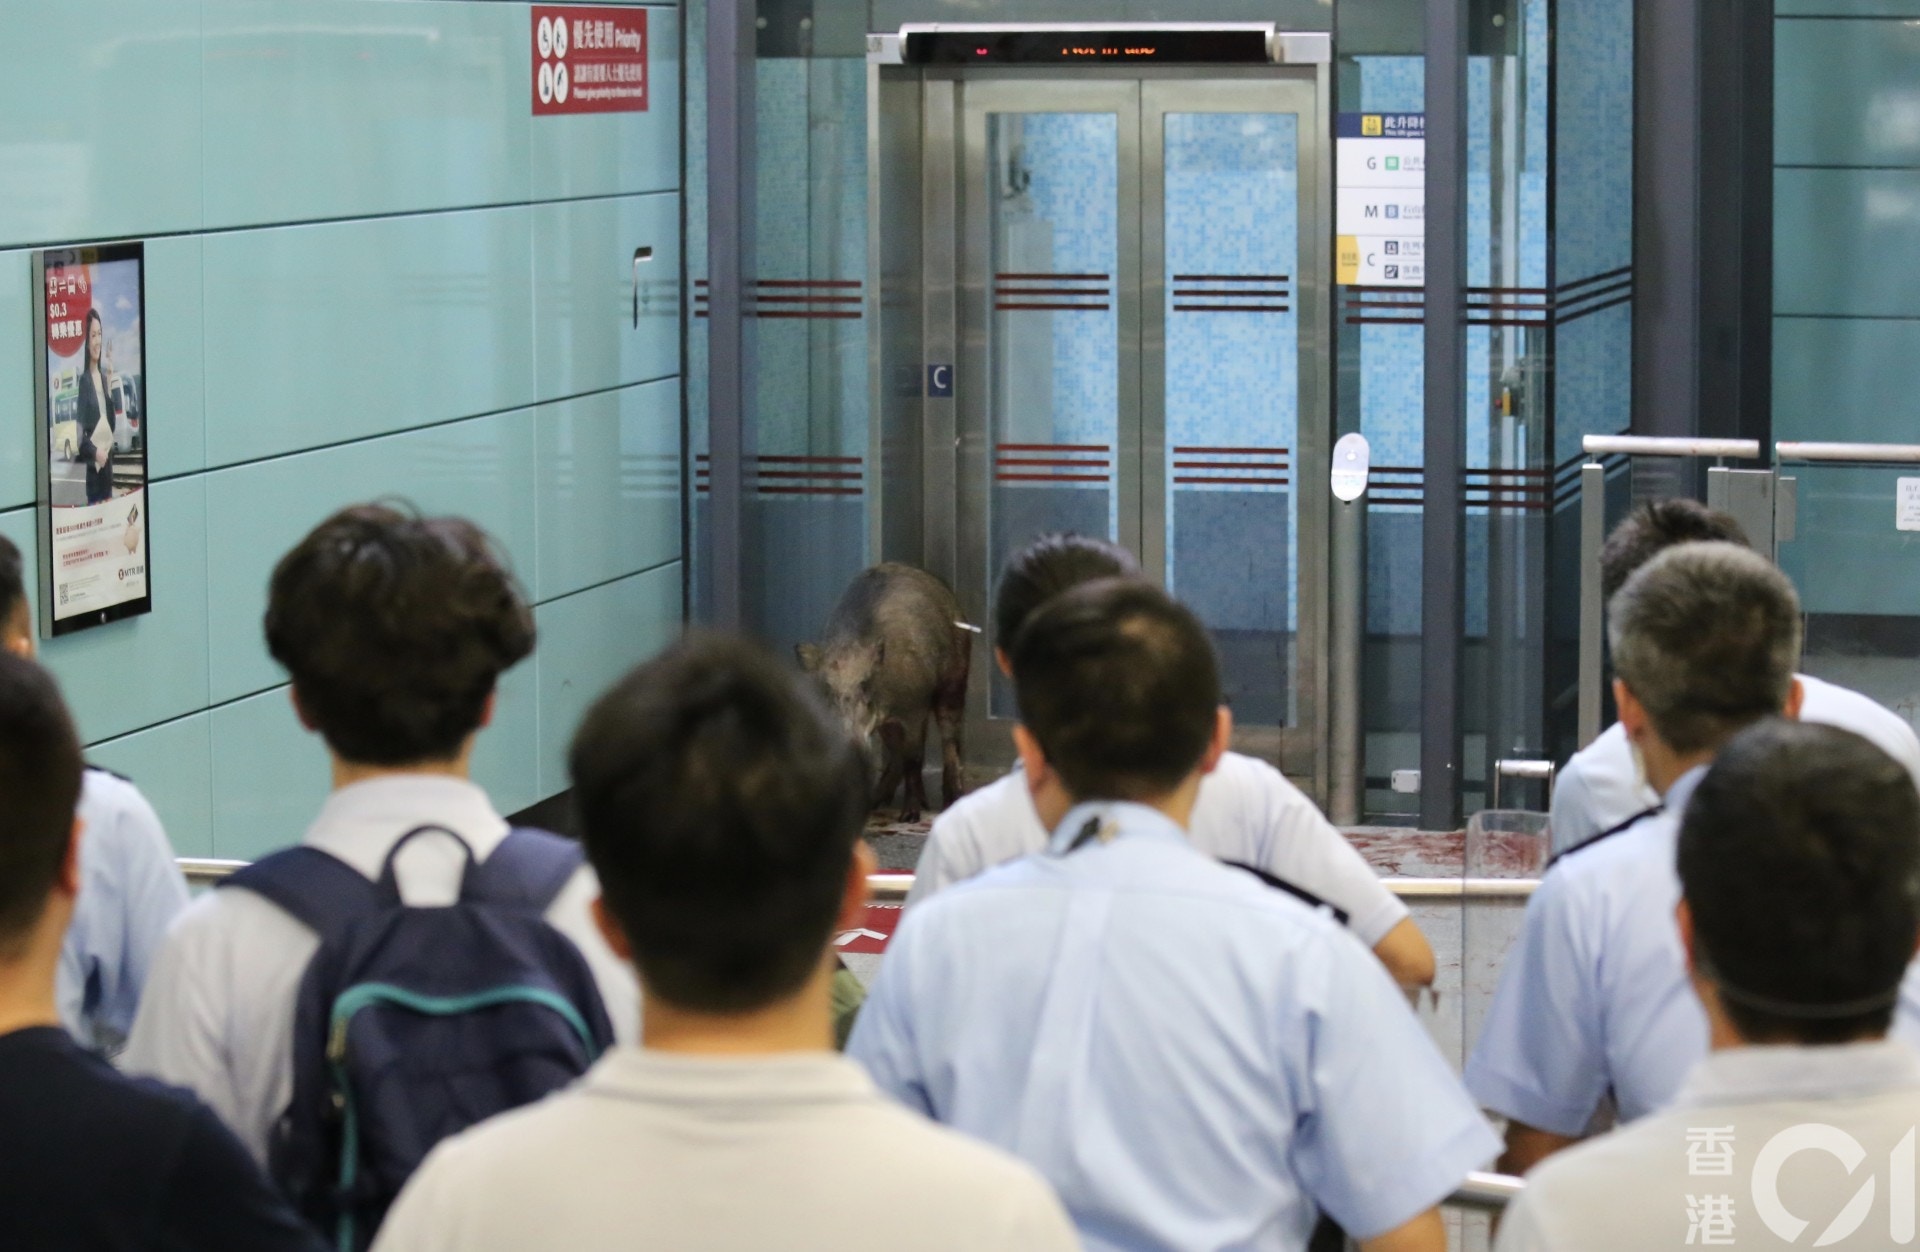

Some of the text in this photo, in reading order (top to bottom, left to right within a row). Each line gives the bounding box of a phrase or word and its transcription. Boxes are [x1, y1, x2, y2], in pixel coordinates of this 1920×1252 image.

[573, 20, 641, 53] 優先使用 Priority
[1367, 157, 1376, 170] G
[1365, 205, 1378, 218] M
[1367, 253, 1375, 267] C
[50, 302, 67, 318] $0.3
[934, 366, 946, 388] C
[124, 568, 136, 576] MTR
